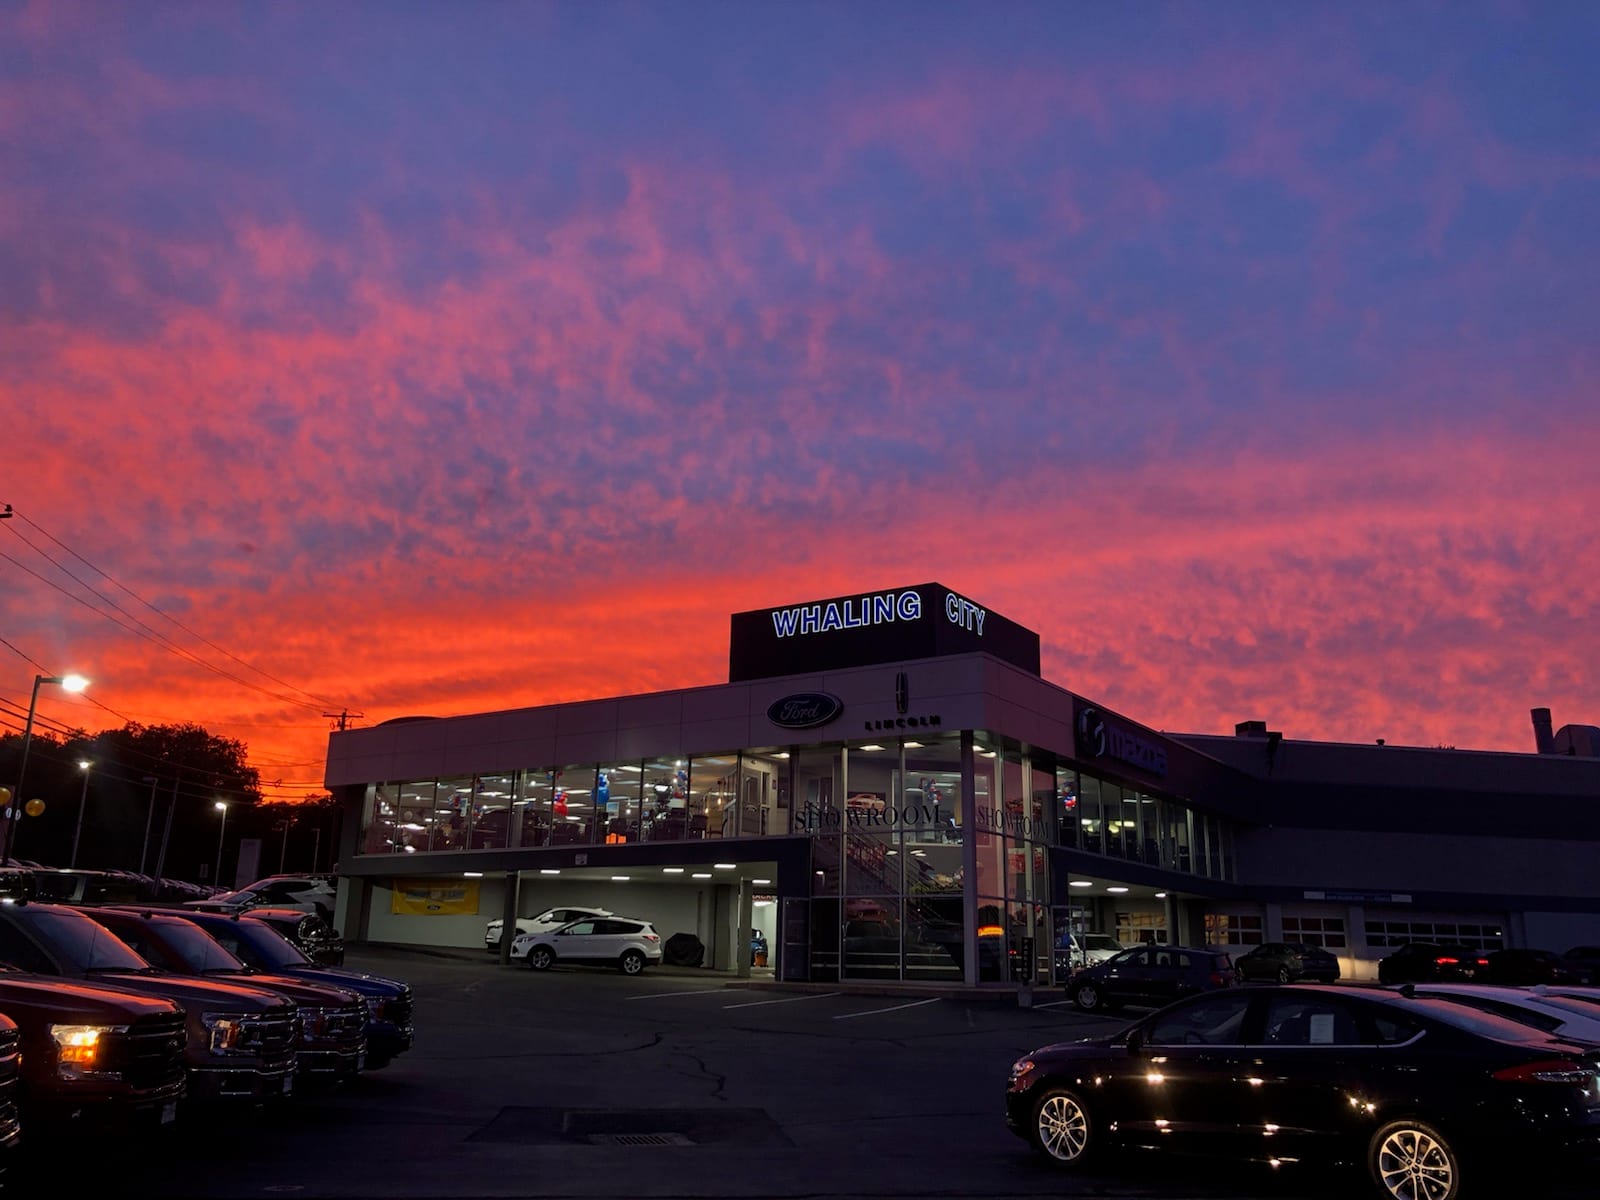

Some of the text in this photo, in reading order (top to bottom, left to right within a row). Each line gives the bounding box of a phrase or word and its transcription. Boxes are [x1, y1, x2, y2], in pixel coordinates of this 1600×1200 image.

[771, 590, 986, 639] WHALING CITY
[865, 715, 941, 731] LINCOLN
[794, 803, 942, 830] SHOWROOM
[977, 804, 1049, 839] SHOWROOM
